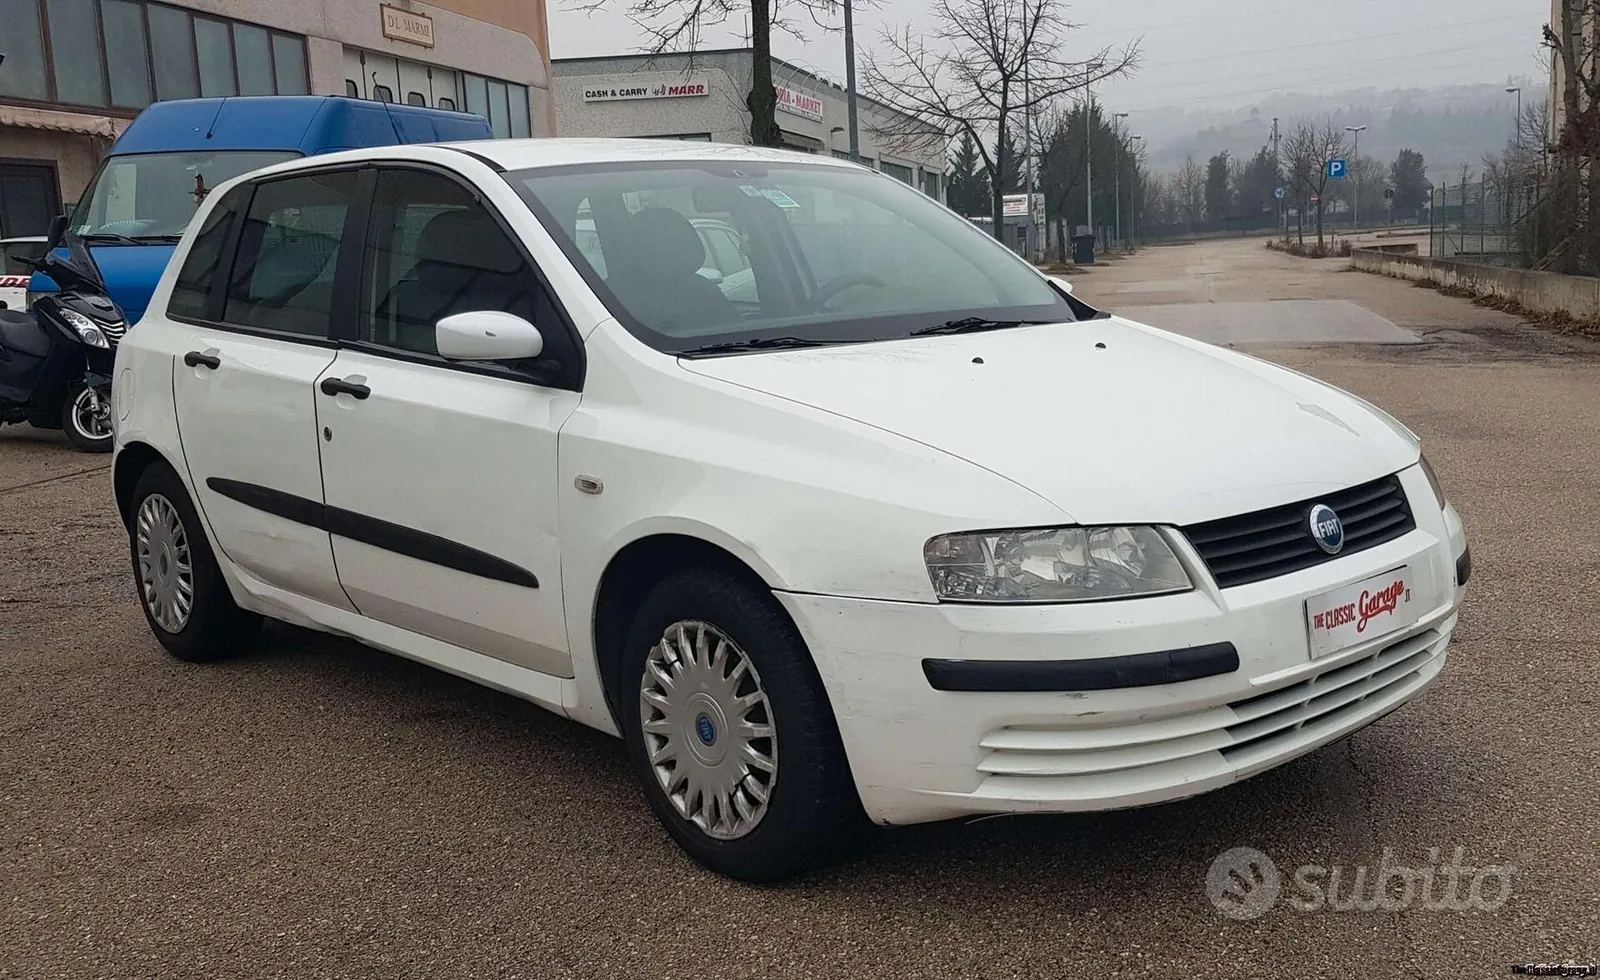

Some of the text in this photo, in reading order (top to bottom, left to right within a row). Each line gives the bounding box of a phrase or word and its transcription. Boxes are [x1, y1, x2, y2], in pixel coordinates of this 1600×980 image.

[403, 19, 430, 37] MARMI
[585, 84, 704, 99] CASH & CARRY MARR
[796, 94, 821, 115] MARKET
[1330, 161, 1342, 176] P
[1317, 518, 1340, 538] FIAT
[1313, 612, 1325, 630] THE
[1325, 603, 1356, 630] CLASSIC
[1356, 580, 1404, 633] Garage
